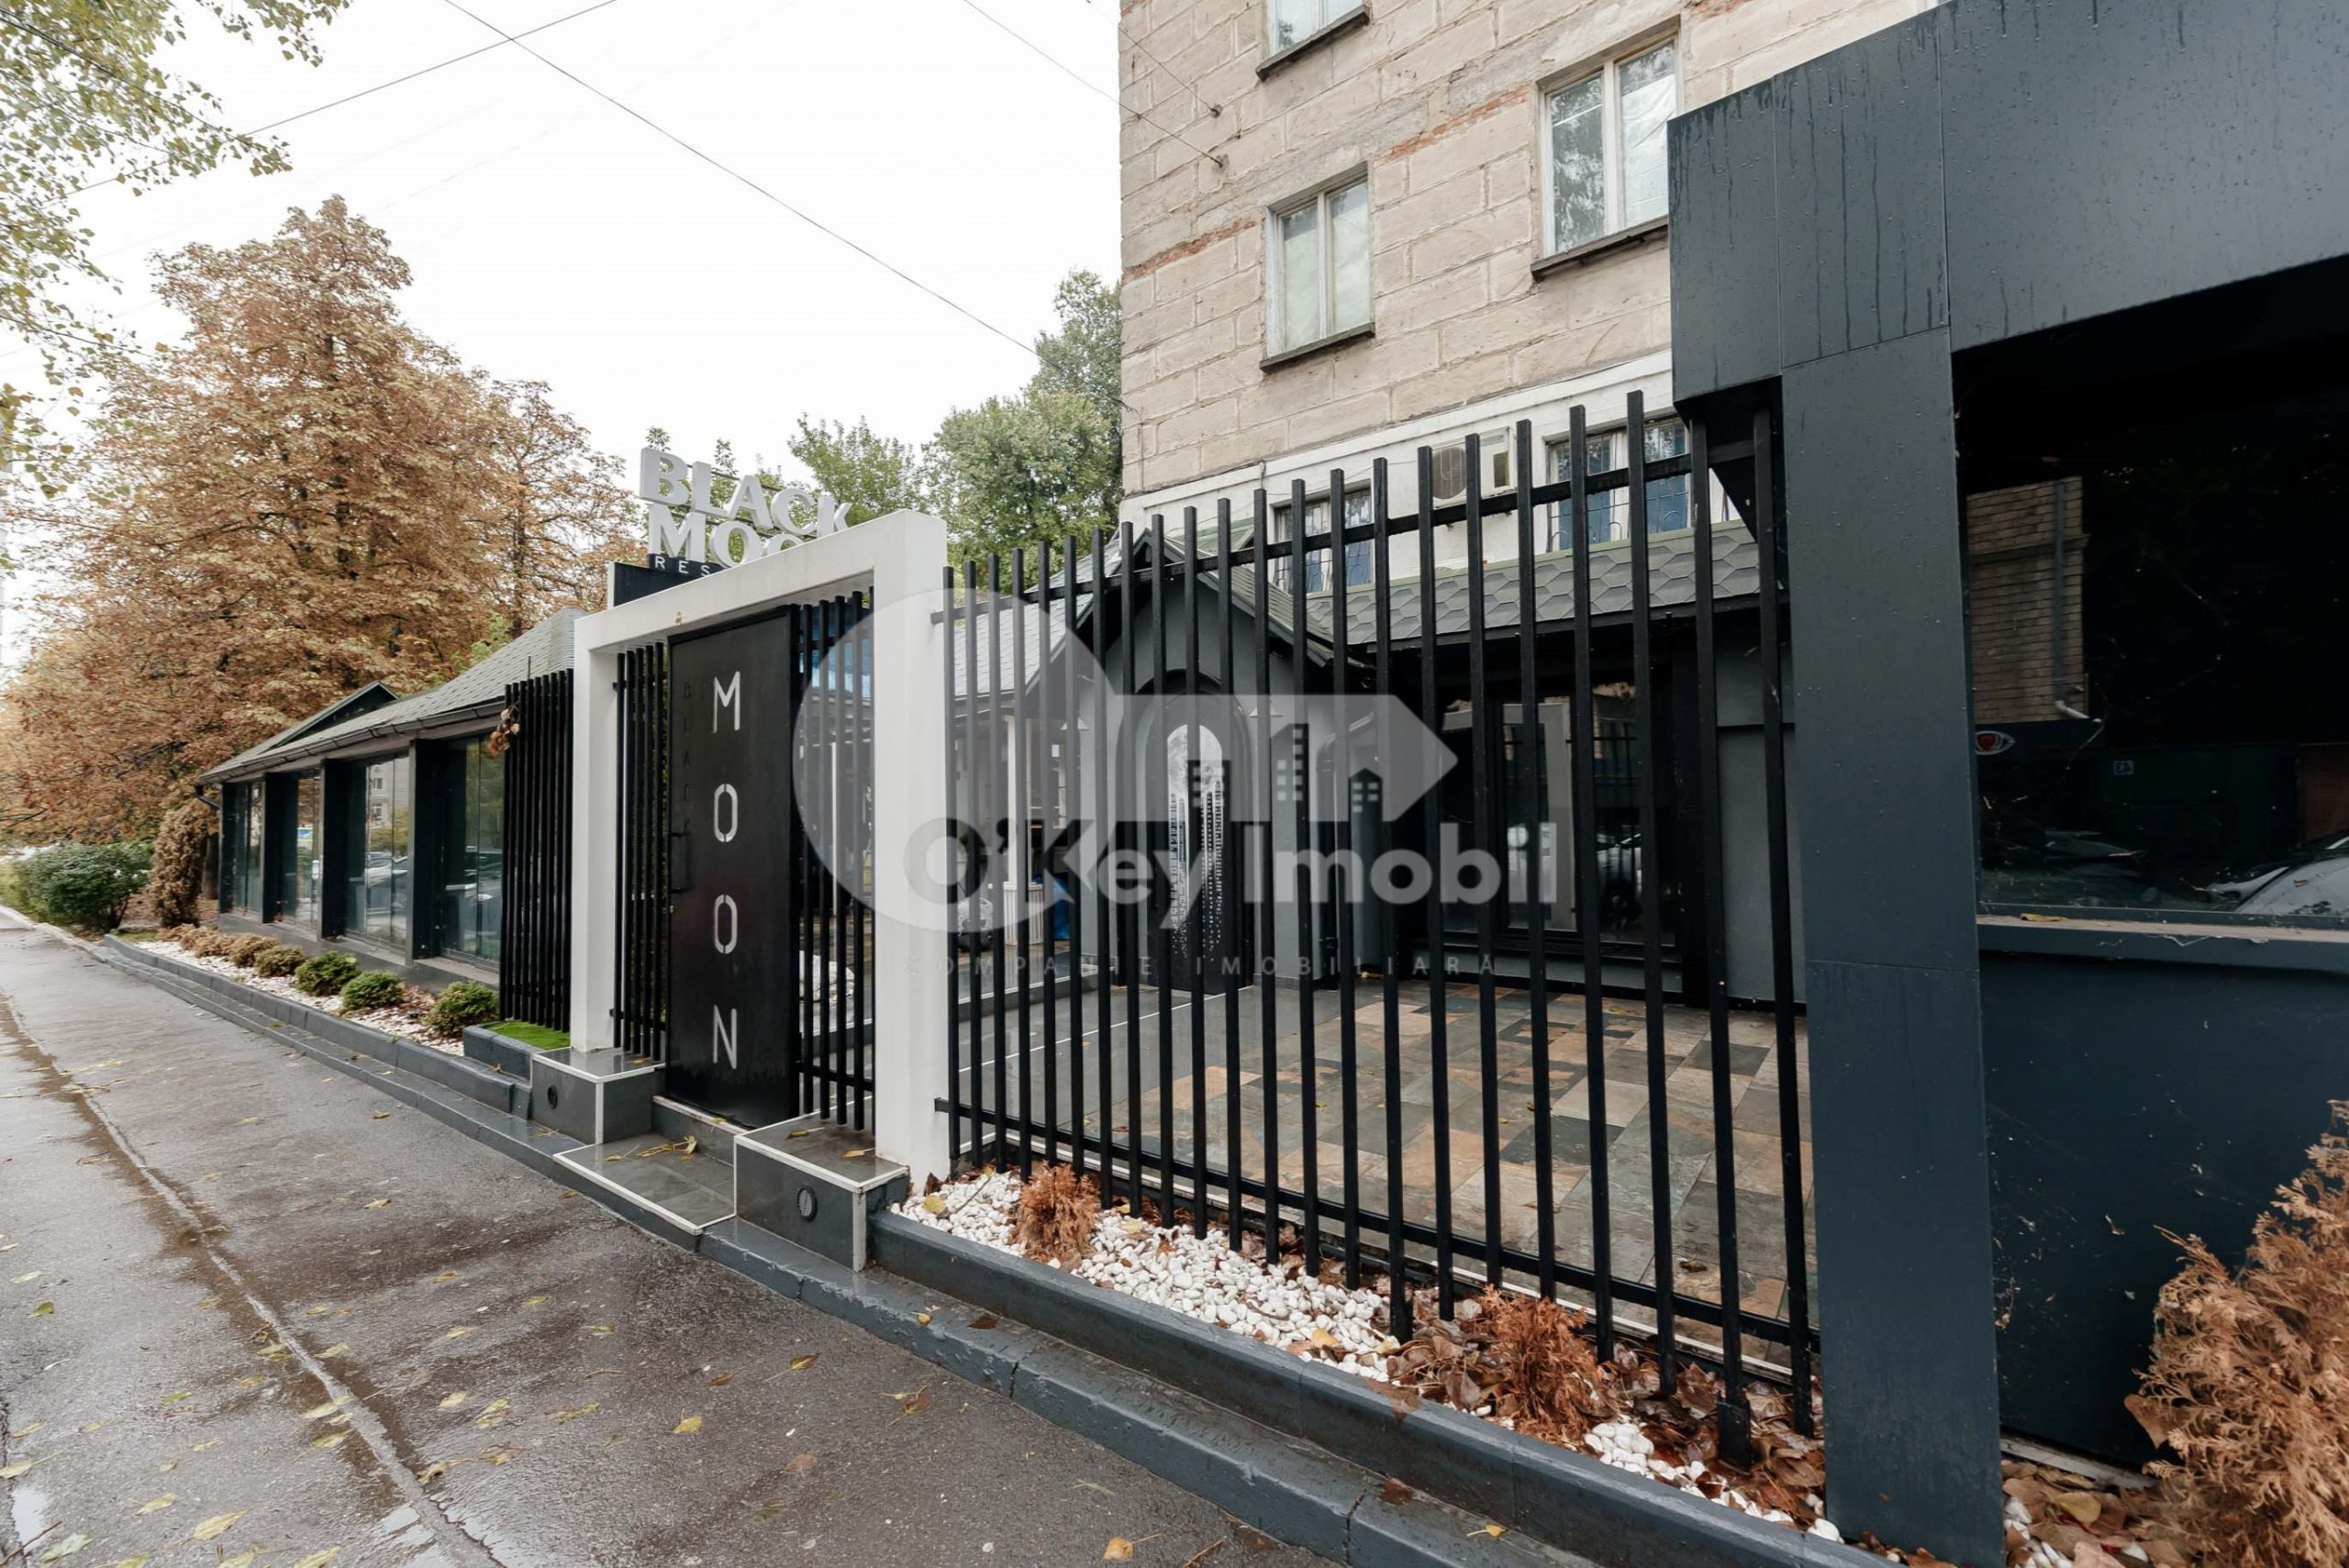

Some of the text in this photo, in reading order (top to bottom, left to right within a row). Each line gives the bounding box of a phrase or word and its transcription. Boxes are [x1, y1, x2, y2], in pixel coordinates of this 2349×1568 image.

[640, 447, 853, 538] BLACK
[654, 553, 711, 578] RES
[713, 672, 740, 1070] MOON
